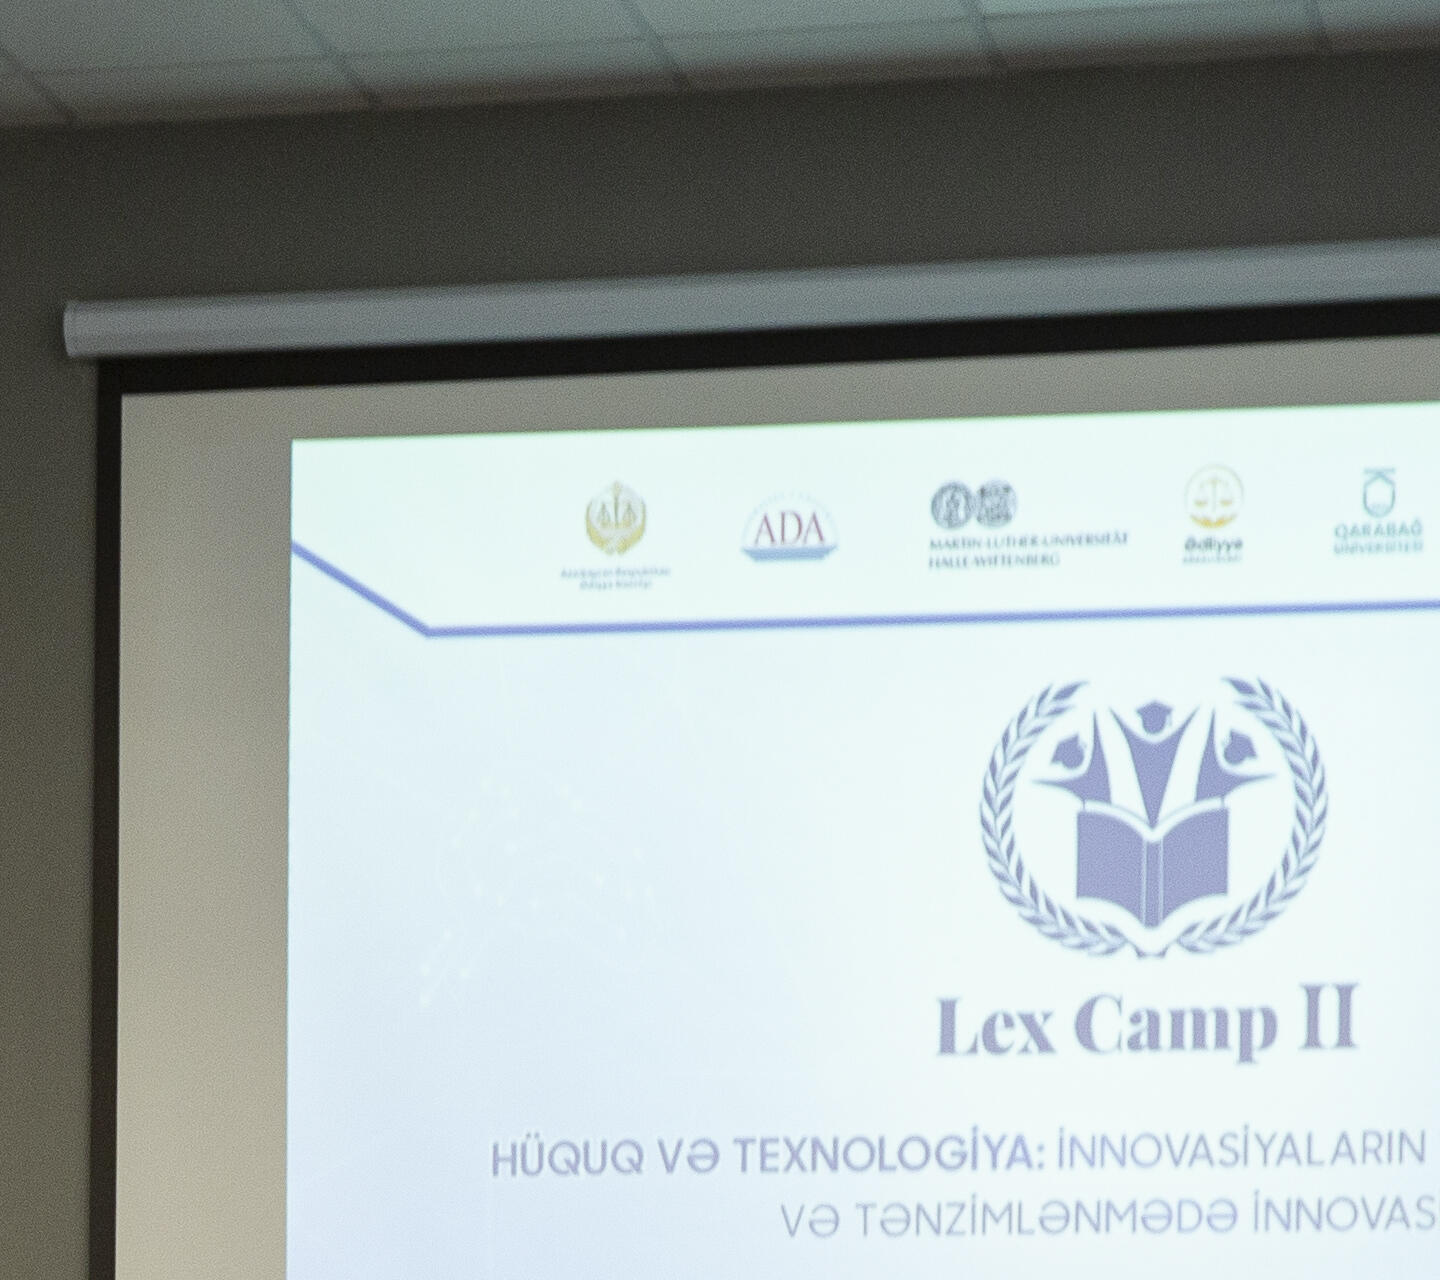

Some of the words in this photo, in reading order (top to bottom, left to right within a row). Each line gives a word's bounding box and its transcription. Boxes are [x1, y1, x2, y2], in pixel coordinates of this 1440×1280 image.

[754, 510, 824, 546] ADA
[939, 998, 1055, 1056] Lex
[1074, 995, 1278, 1064] Camp
[1302, 983, 1356, 1050] II
[491, 1133, 644, 1180] HÜQUQ
[658, 1138, 720, 1174] VƏ
[733, 1125, 1044, 1173] TEXNOLOGİYA:
[1058, 1124, 1426, 1169] İNNOVASİYALARIN
[780, 1204, 840, 1238] VƏ
[856, 1194, 1239, 1237] TƏNZİMLƏNMƏDƏ
